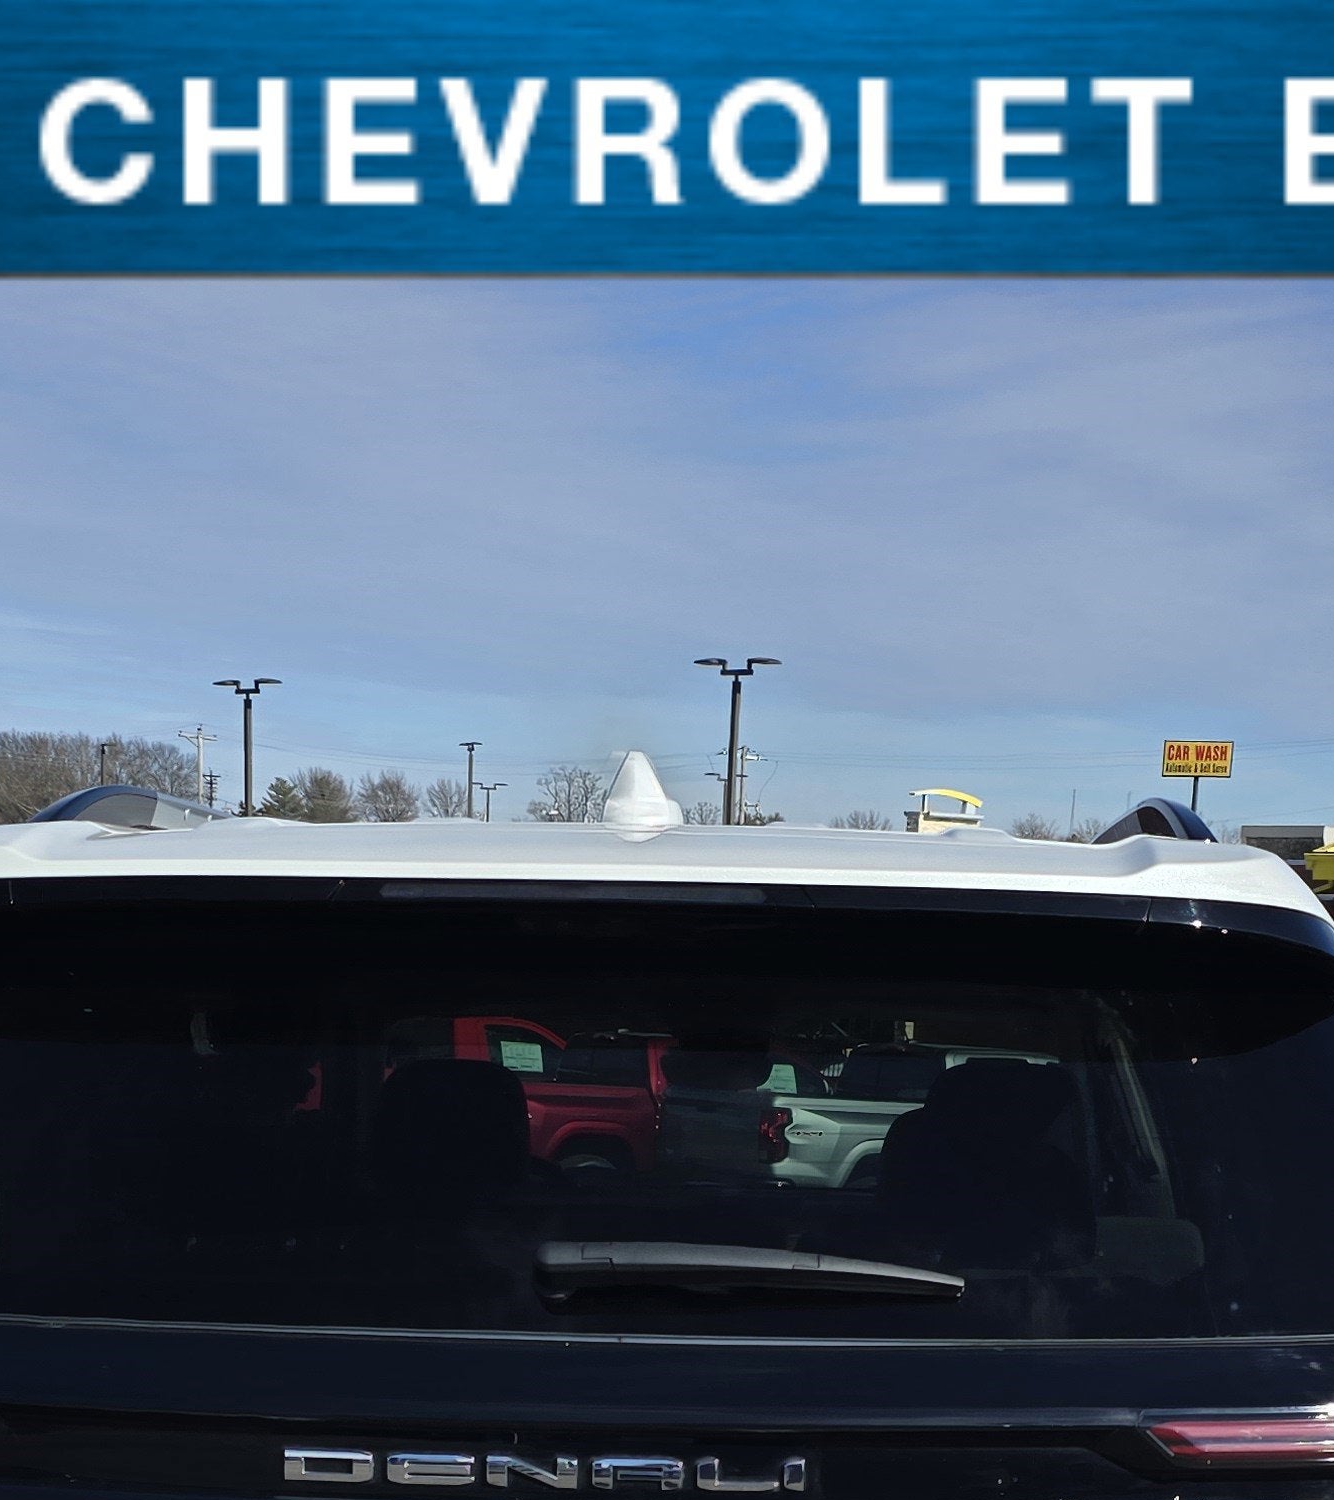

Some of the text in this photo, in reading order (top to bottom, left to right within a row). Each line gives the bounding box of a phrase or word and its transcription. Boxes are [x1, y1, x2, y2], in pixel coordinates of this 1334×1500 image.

[1168, 745, 1227, 761] CAR WASH
[283, 1447, 806, 1493] DENALI
